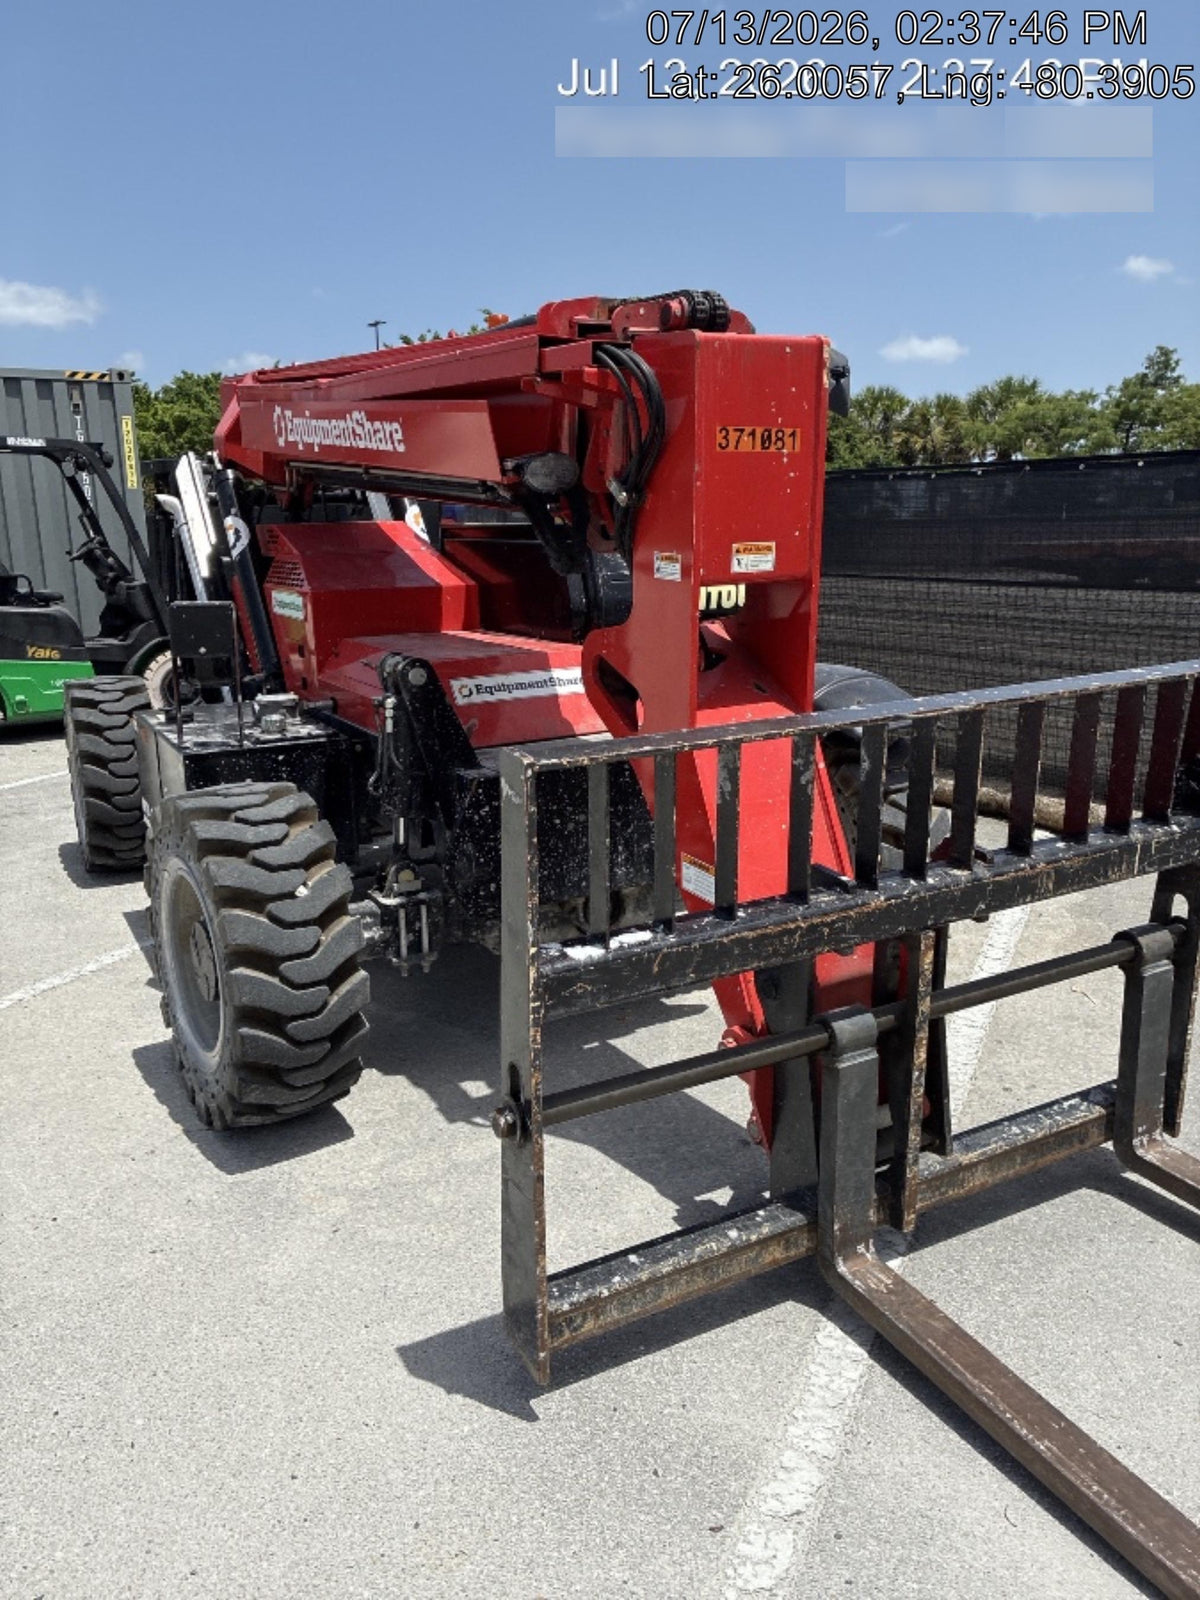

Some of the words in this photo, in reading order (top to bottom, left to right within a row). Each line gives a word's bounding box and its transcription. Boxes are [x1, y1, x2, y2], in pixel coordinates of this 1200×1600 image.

[284, 408, 406, 453] EquipmentShare
[717, 426, 798, 451] 371081
[26, 644, 61, 660] Yale
